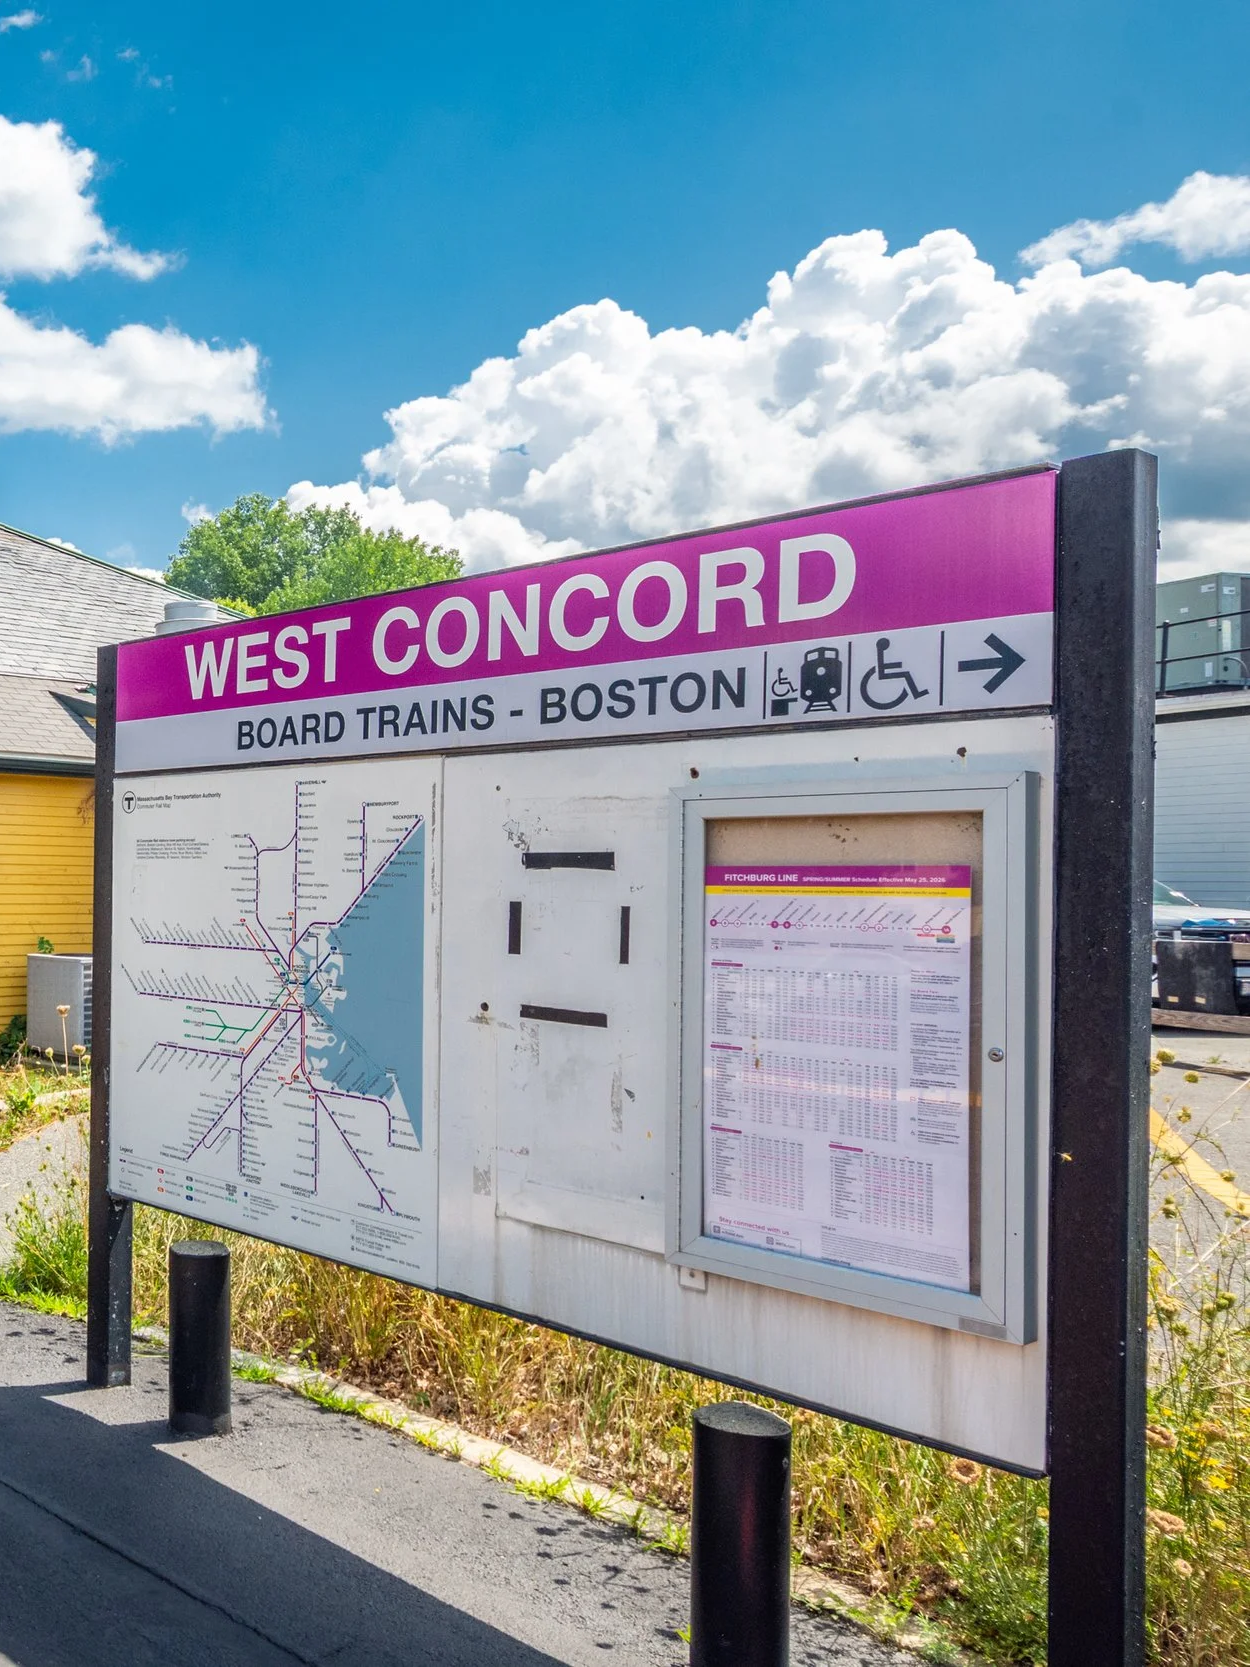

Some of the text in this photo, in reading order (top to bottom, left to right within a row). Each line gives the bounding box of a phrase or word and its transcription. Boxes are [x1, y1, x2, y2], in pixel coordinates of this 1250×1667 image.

[184, 533, 856, 700] WEST CONCORD
[237, 711, 345, 750] BOARD
[356, 694, 495, 740] TRAINS
[540, 667, 746, 724] BOSTON
[724, 874, 776, 882] FITCHBURG
[778, 874, 798, 882] LINE
[719, 1216, 732, 1224] Stay
[733, 1220, 766, 1230] connected
